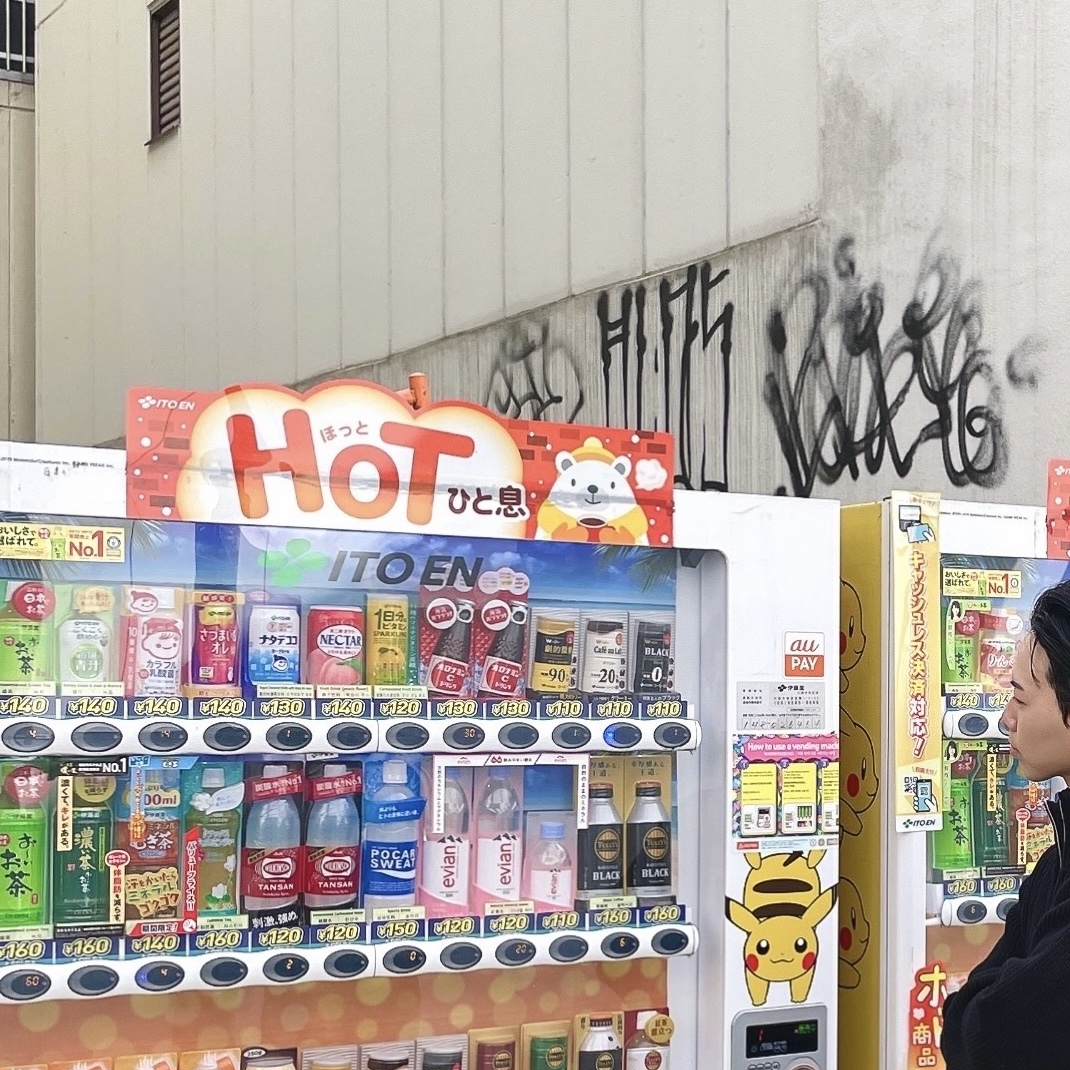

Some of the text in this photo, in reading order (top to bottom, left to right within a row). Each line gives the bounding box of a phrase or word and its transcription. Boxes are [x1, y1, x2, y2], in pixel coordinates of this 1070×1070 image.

[155, 398, 195, 411] ITO EN
[319, 421, 370, 443] ほっと
[447, 484, 527, 520] ひと息
[69, 530, 104, 557] No.1
[328, 548, 485, 587] ITO EN
[988, 573, 1008, 594] No.1
[212, 642, 229, 654] オレ
[259, 634, 298, 645] ナタデココ
[320, 634, 362, 647] NECTAR
[790, 638, 820, 652] au
[791, 656, 819, 671] PAY
[549, 668, 565, 682] 90
[599, 668, 615, 683] 20
[0, 696, 48, 714] ¥140
[69, 697, 116, 714] ¥140
[134, 699, 181, 715] ¥140
[200, 699, 246, 715] ¥140
[262, 700, 305, 717] ¥130
[321, 700, 365, 717] ¥140
[380, 700, 423, 717] ¥120
[437, 700, 477, 717] ¥130
[491, 702, 531, 717] ¥130
[546, 701, 583, 717] ¥110
[597, 701, 632, 717] ¥110
[647, 701, 682, 717] ¥110
[102, 758, 127, 773] NO.1
[949, 809, 969, 846] お茶
[440, 845, 456, 888] evian
[499, 842, 512, 886] evian
[0, 849, 33, 898] お茶
[593, 871, 621, 881] BLACK
[642, 868, 669, 878] BLACK
[490, 913, 532, 932] ¥120
[542, 911, 580, 930] ¥110
[594, 908, 631, 926] ¥160
[644, 905, 679, 923] ¥160
[317, 924, 360, 941] ¥120
[377, 921, 419, 937] ¥150
[434, 917, 474, 934] ¥120
[133, 935, 179, 951] ¥140
[197, 931, 241, 948] ¥160
[259, 928, 303, 945] ¥120
[63, 938, 112, 957] ¥160
[912, 1023, 937, 1068] 商品
